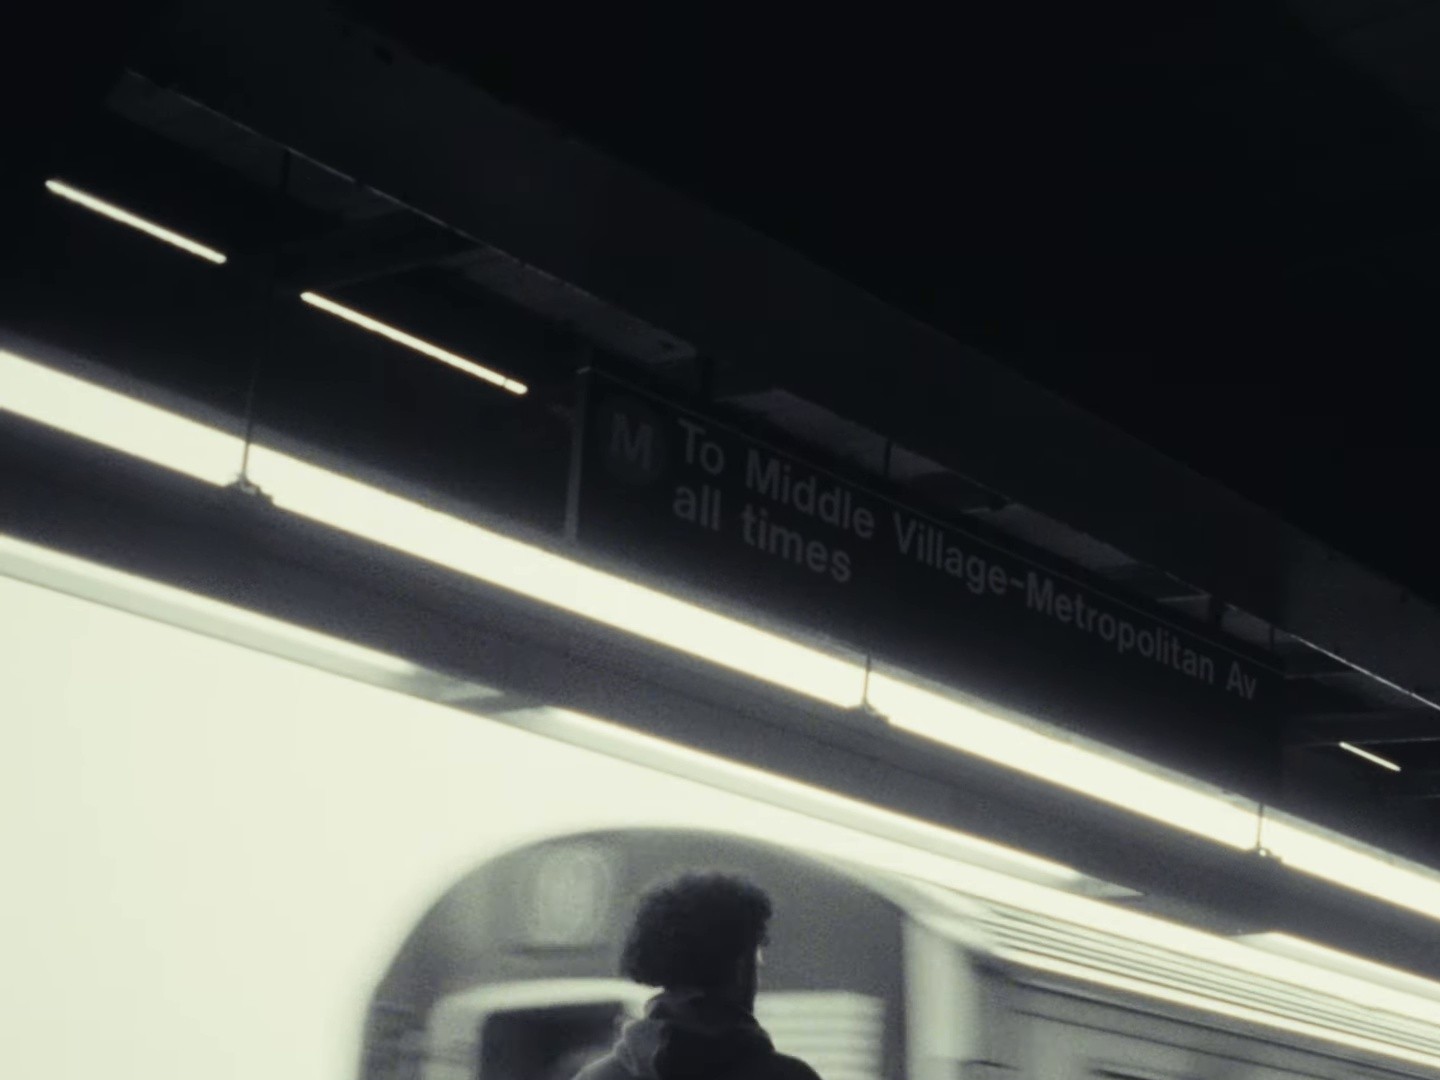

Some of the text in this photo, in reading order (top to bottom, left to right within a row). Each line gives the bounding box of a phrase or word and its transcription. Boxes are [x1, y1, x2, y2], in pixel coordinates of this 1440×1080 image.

[609, 411, 653, 471] M
[672, 484, 852, 583] all times
[677, 417, 1257, 701] To Middle Village-Metropolitan Av
